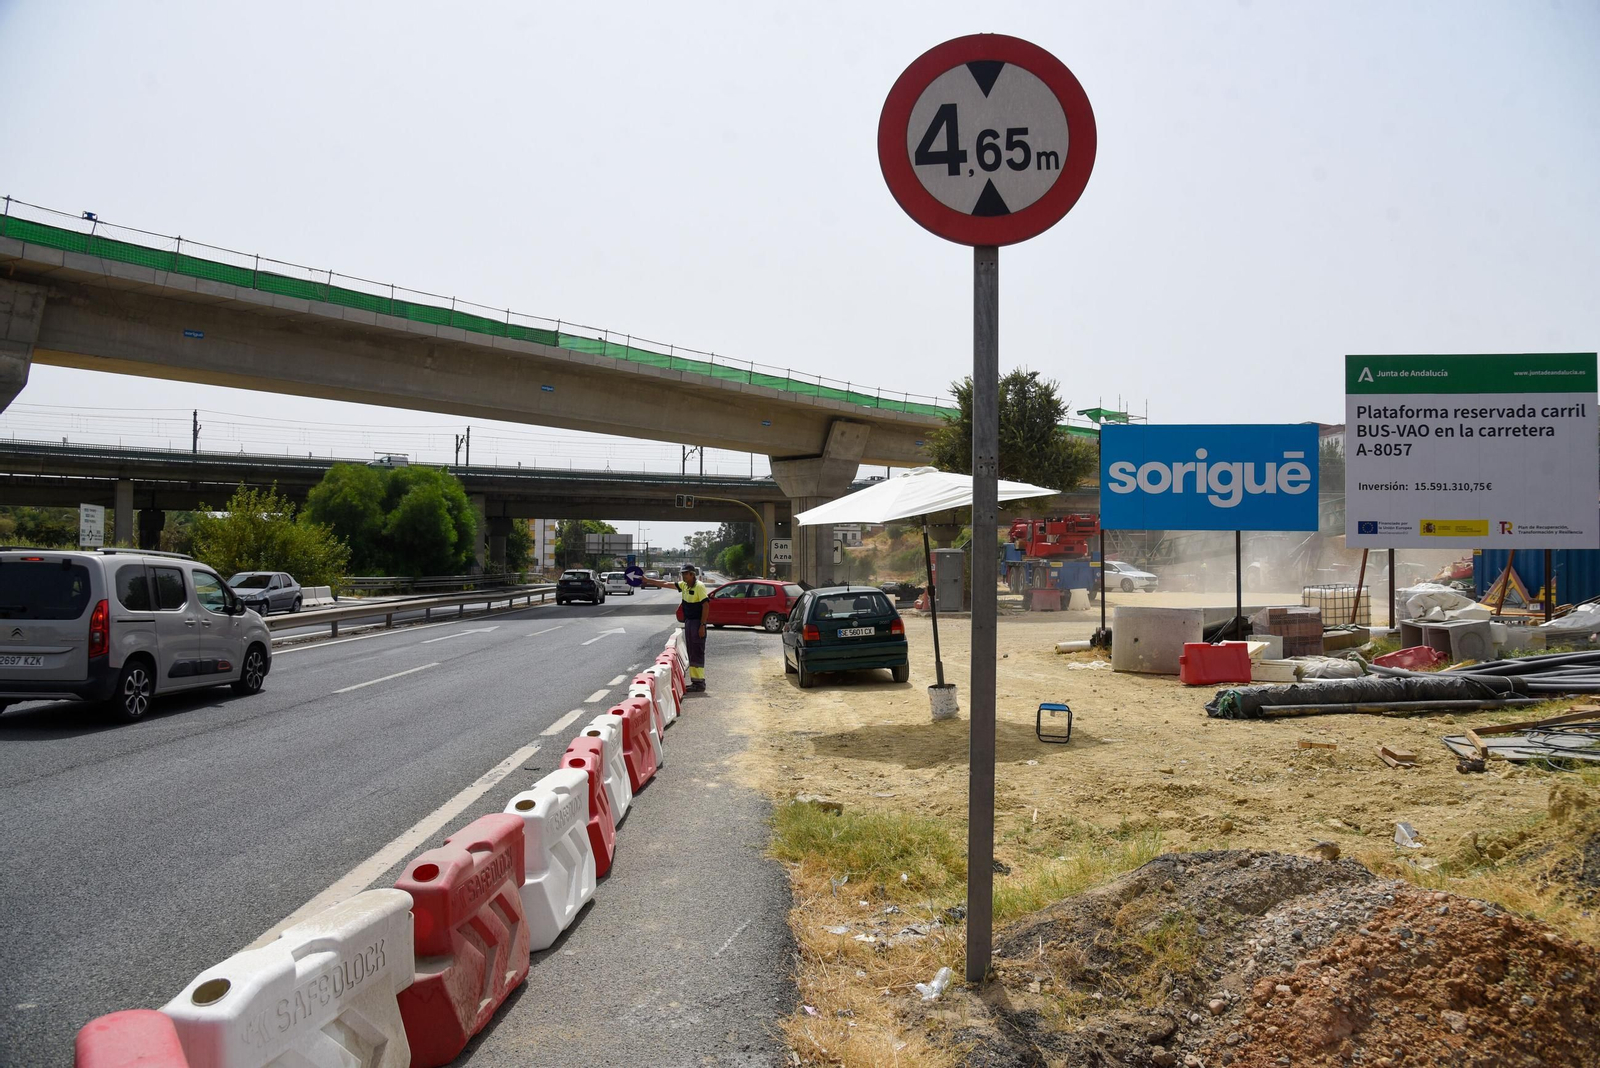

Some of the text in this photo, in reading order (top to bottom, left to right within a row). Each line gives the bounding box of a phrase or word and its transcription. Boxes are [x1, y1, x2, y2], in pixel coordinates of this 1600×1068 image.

[1410, 369, 1449, 377] Andalucía
[1356, 403, 1586, 419] Plataforma reservada carril
[1356, 424, 1555, 438] BUS-VAO en la carretera
[1356, 443, 1413, 456] A-8057
[1358, 481, 1409, 491] Inversión:
[23, 656, 42, 666] KZK
